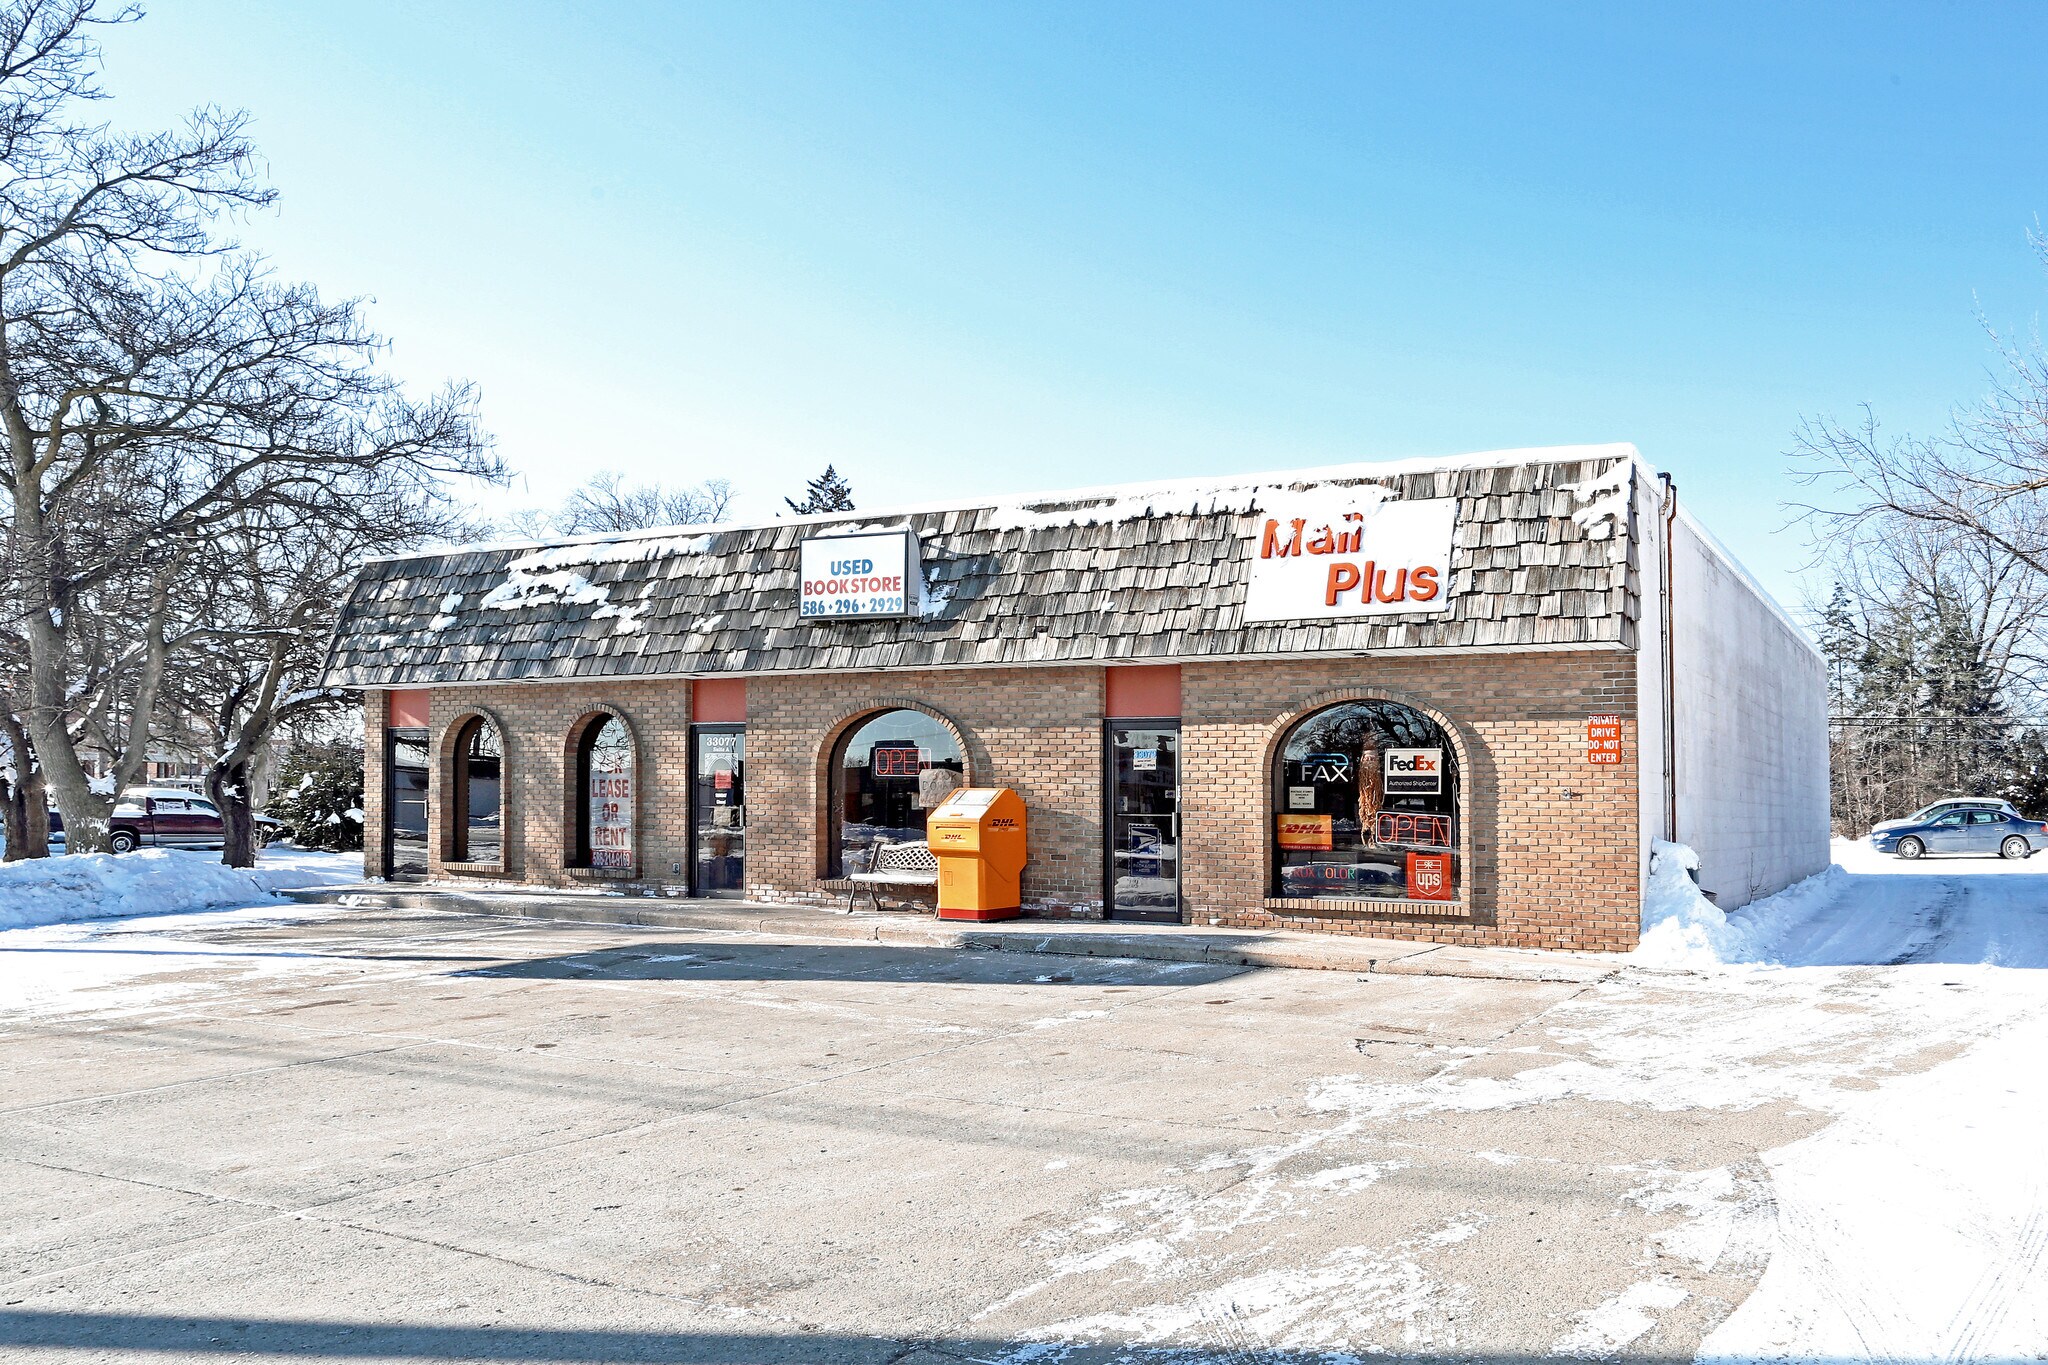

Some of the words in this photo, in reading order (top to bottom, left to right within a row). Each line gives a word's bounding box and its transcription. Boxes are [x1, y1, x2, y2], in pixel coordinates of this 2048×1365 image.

[1261, 512, 1364, 558] Mail
[830, 559, 873, 576] USED
[804, 576, 902, 596] BOOKSTORE
[1325, 560, 1439, 606] Plus
[1588, 715, 1619, 725] PRIVATE
[1591, 728, 1616, 737] DRIVE
[706, 736, 737, 747] 33077
[876, 749, 931, 775] OPEN
[1389, 755, 1436, 771] FedEx
[1591, 753, 1617, 763] ENTER
[1301, 765, 1349, 782] FAX
[592, 779, 630, 798] LEASE
[602, 803, 619, 821] OR
[992, 818, 1015, 827] DHL
[1285, 823, 1326, 834] DHL
[1378, 813, 1449, 847] OPEN
[594, 827, 627, 846] RENT
[1317, 867, 1356, 879] COLOR
[1417, 873, 1440, 890] ups
